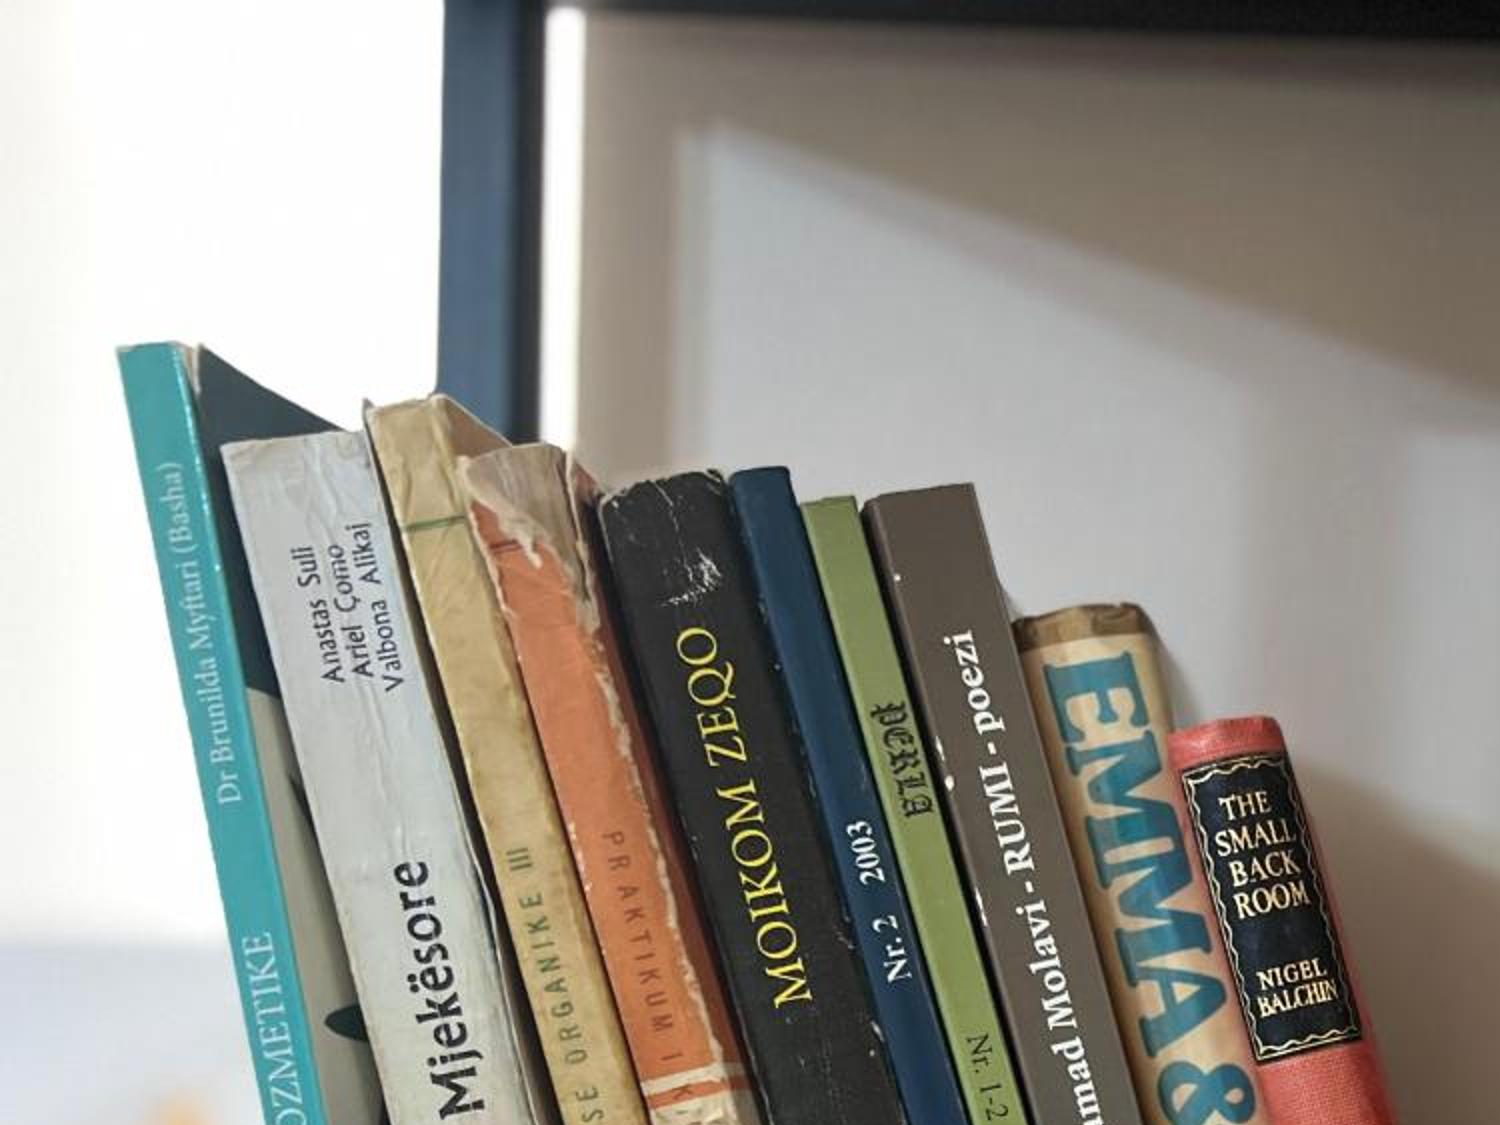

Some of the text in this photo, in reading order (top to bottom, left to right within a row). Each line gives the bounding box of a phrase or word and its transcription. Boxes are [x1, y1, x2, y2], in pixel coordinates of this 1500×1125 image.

[157, 462, 197, 555] (Basha)
[291, 546, 345, 683] Anastas Suli
[329, 544, 374, 678] Ariel Çomo
[345, 522, 404, 692] Valbona Alikaj
[195, 657, 235, 764] Brunilda
[943, 629, 1006, 736] poezi
[218, 769, 241, 804] Dr
[870, 701, 933, 817] PERLA
[1219, 790, 1272, 822] THE
[506, 846, 534, 873] III
[676, 626, 813, 1009] MOIKOM ZEQO
[978, 761, 1035, 876] RUMI
[1043, 651, 1227, 1057] EMMA
[1215, 818, 1298, 858] SMALL
[1228, 849, 1302, 888] BACK
[601, 829, 683, 1062] PRAKTIKUM I
[846, 820, 913, 984] Nr. 2 2003
[1232, 881, 1313, 920] ROOM
[394, 861, 485, 1120] Mjekësore
[520, 892, 588, 1066] ORGANIKE
[1016, 899, 1078, 1031] Molavi
[1256, 957, 1328, 992] NIGEL
[1257, 976, 1340, 1019] BALCHIN
[966, 1033, 992, 1074] Nr.
